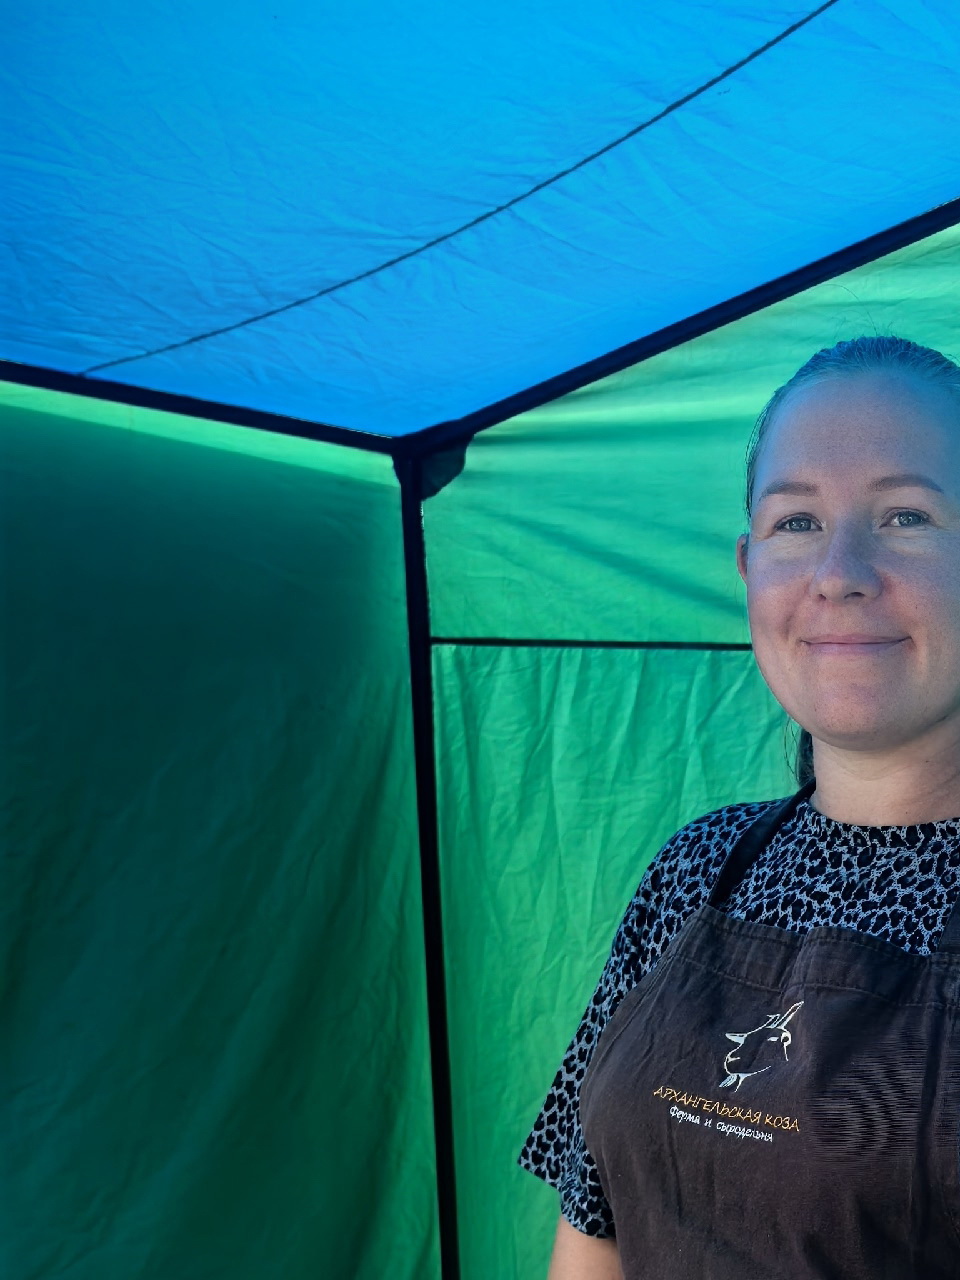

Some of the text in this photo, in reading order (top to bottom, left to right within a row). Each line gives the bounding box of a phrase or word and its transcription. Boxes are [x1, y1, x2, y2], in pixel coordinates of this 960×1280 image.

[653, 1085, 800, 1132] АРХАНГЕЛЬСКАЯ КОЗА
[669, 1105, 773, 1143] Ферма и сыродельня
